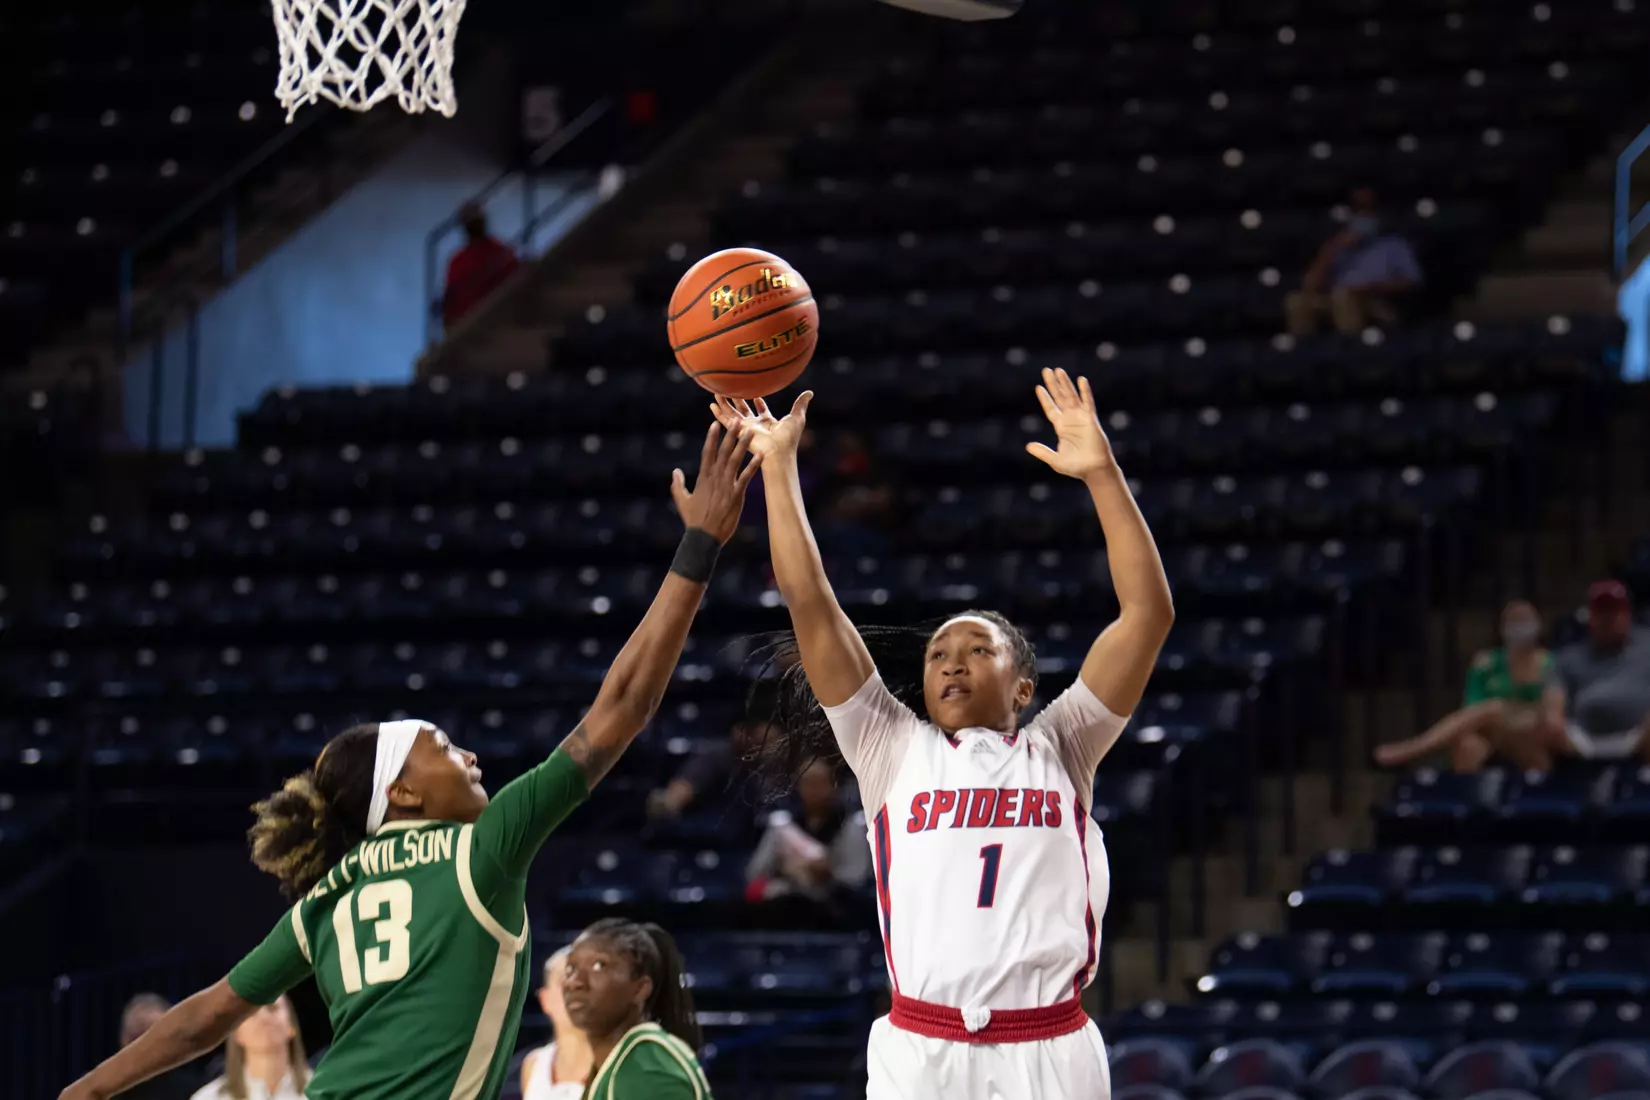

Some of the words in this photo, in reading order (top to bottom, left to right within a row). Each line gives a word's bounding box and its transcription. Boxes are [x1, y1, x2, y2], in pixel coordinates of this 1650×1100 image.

[734, 318, 812, 359] ELITE
[907, 788, 1062, 833] SPIDERS
[976, 844, 1003, 908] 1
[332, 878, 413, 994] 13
